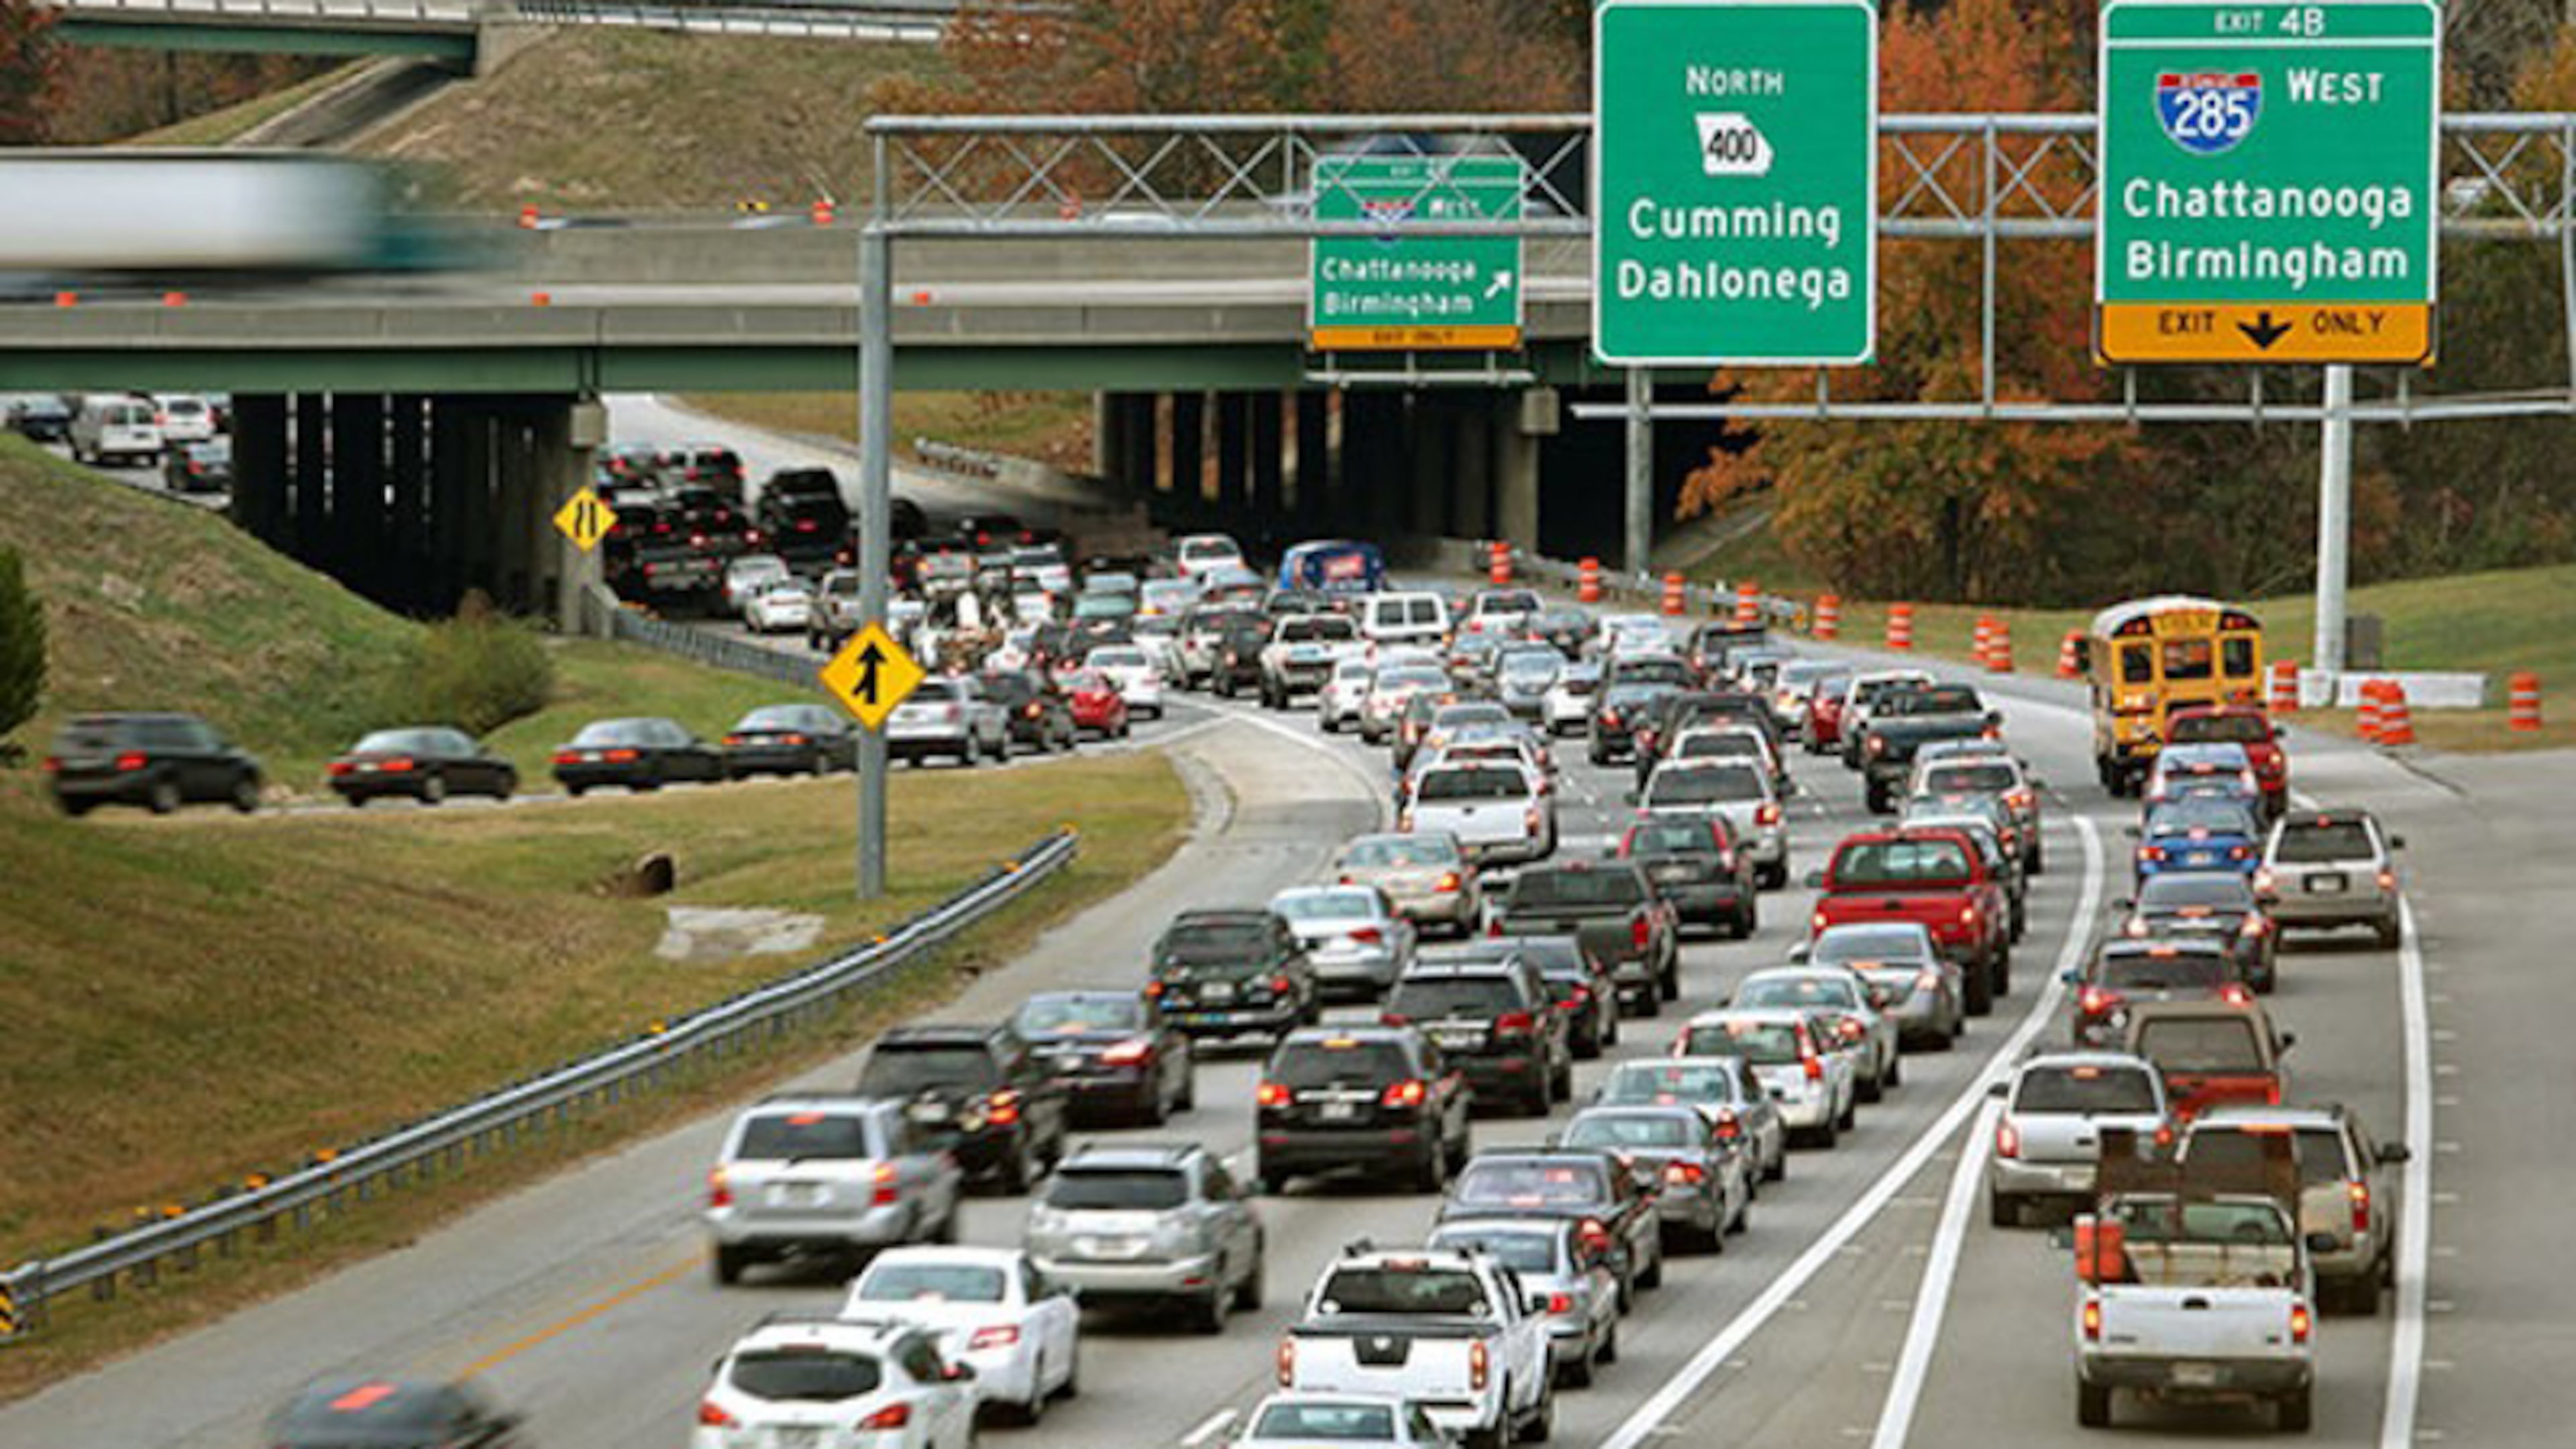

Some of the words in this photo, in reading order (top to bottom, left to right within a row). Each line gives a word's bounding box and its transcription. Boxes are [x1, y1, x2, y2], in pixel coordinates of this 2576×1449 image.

[2215, 11, 2263, 32] EXIT
[2279, 8, 2326, 36] 4B
[1685, 65, 1785, 96] NORTH
[2286, 68, 2384, 103] WEST
[2173, 90, 2251, 138] 285
[1706, 128, 1757, 163] 400
[2123, 178, 2412, 229] Chattanooga
[1627, 197, 1843, 249] Cumming
[1321, 256, 1477, 285] Chattanooga
[2126, 239, 2408, 290] Birmingham
[1616, 259, 1851, 311] Dahlonega
[1324, 292, 1474, 317] Birmingham
[2157, 311, 2215, 334] EXIT
[2312, 311, 2387, 334] ONLY
